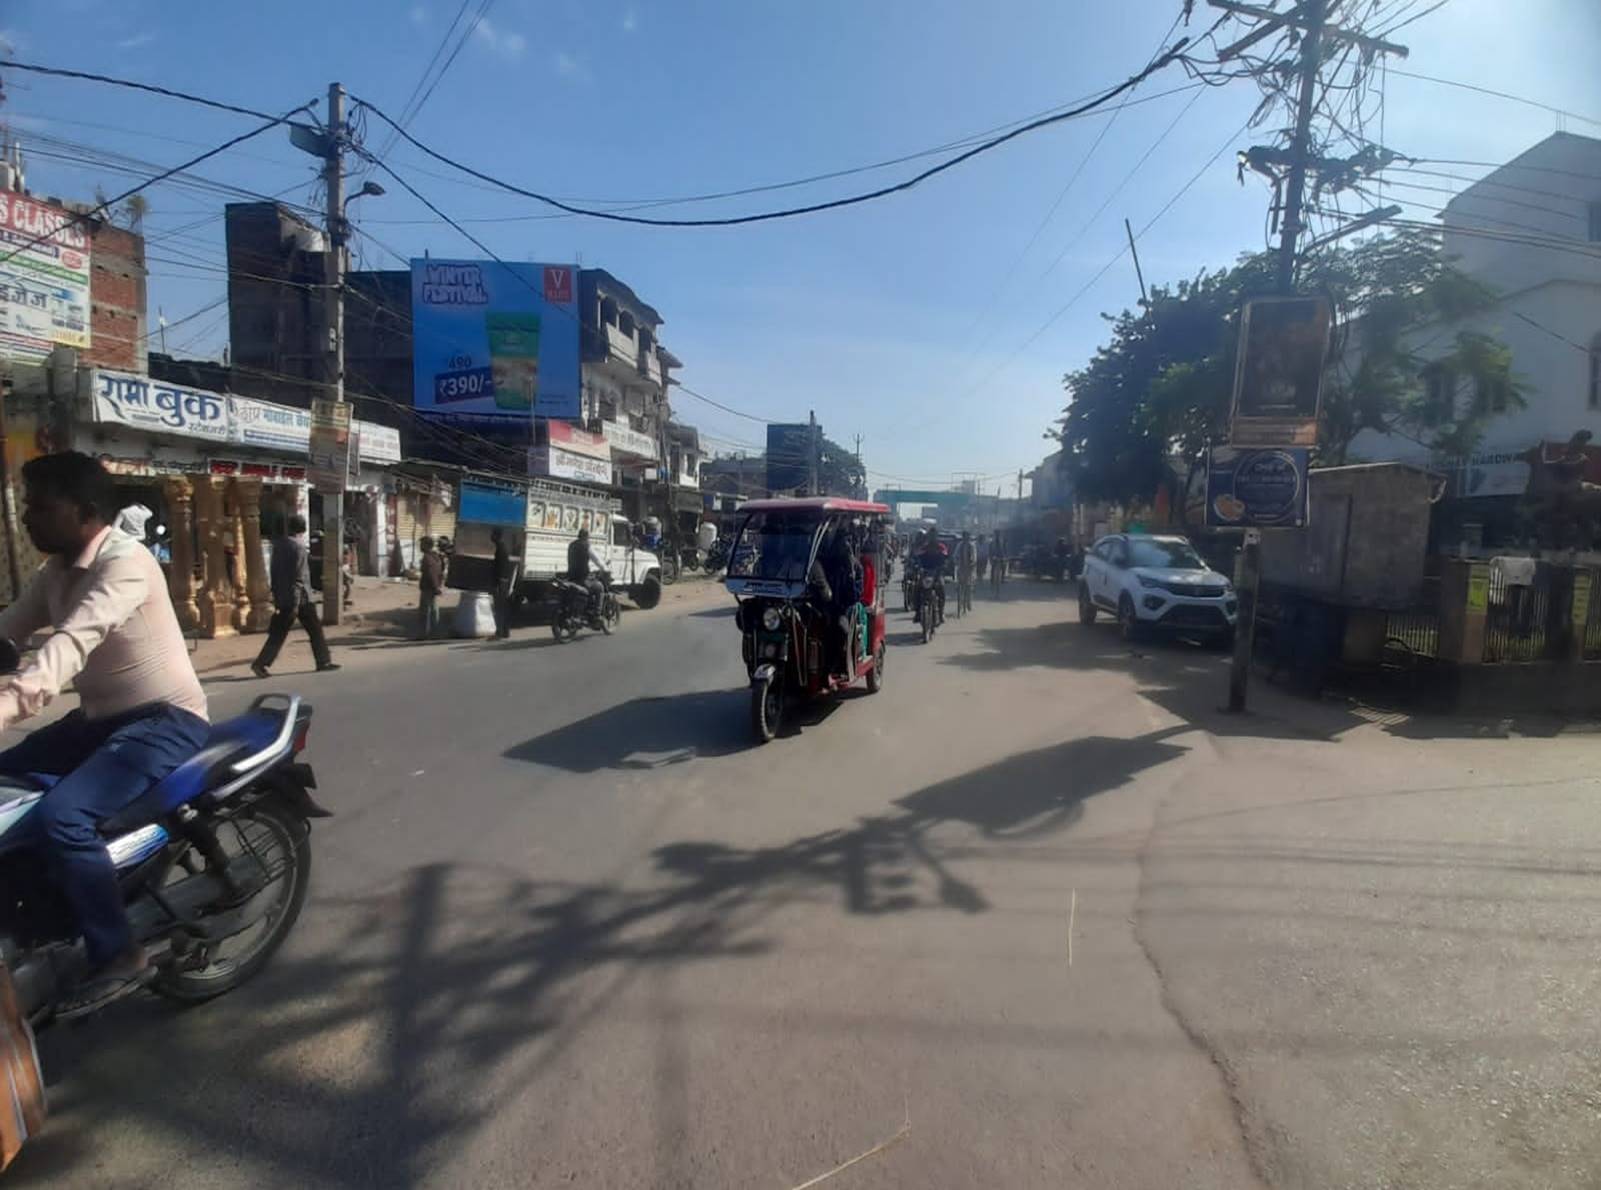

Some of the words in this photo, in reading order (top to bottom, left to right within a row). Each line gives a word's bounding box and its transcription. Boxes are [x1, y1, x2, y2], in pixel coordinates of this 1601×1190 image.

[14, 199, 86, 248] CLASSES
[550, 268, 566, 289] V
[153, 384, 223, 426] बुक
